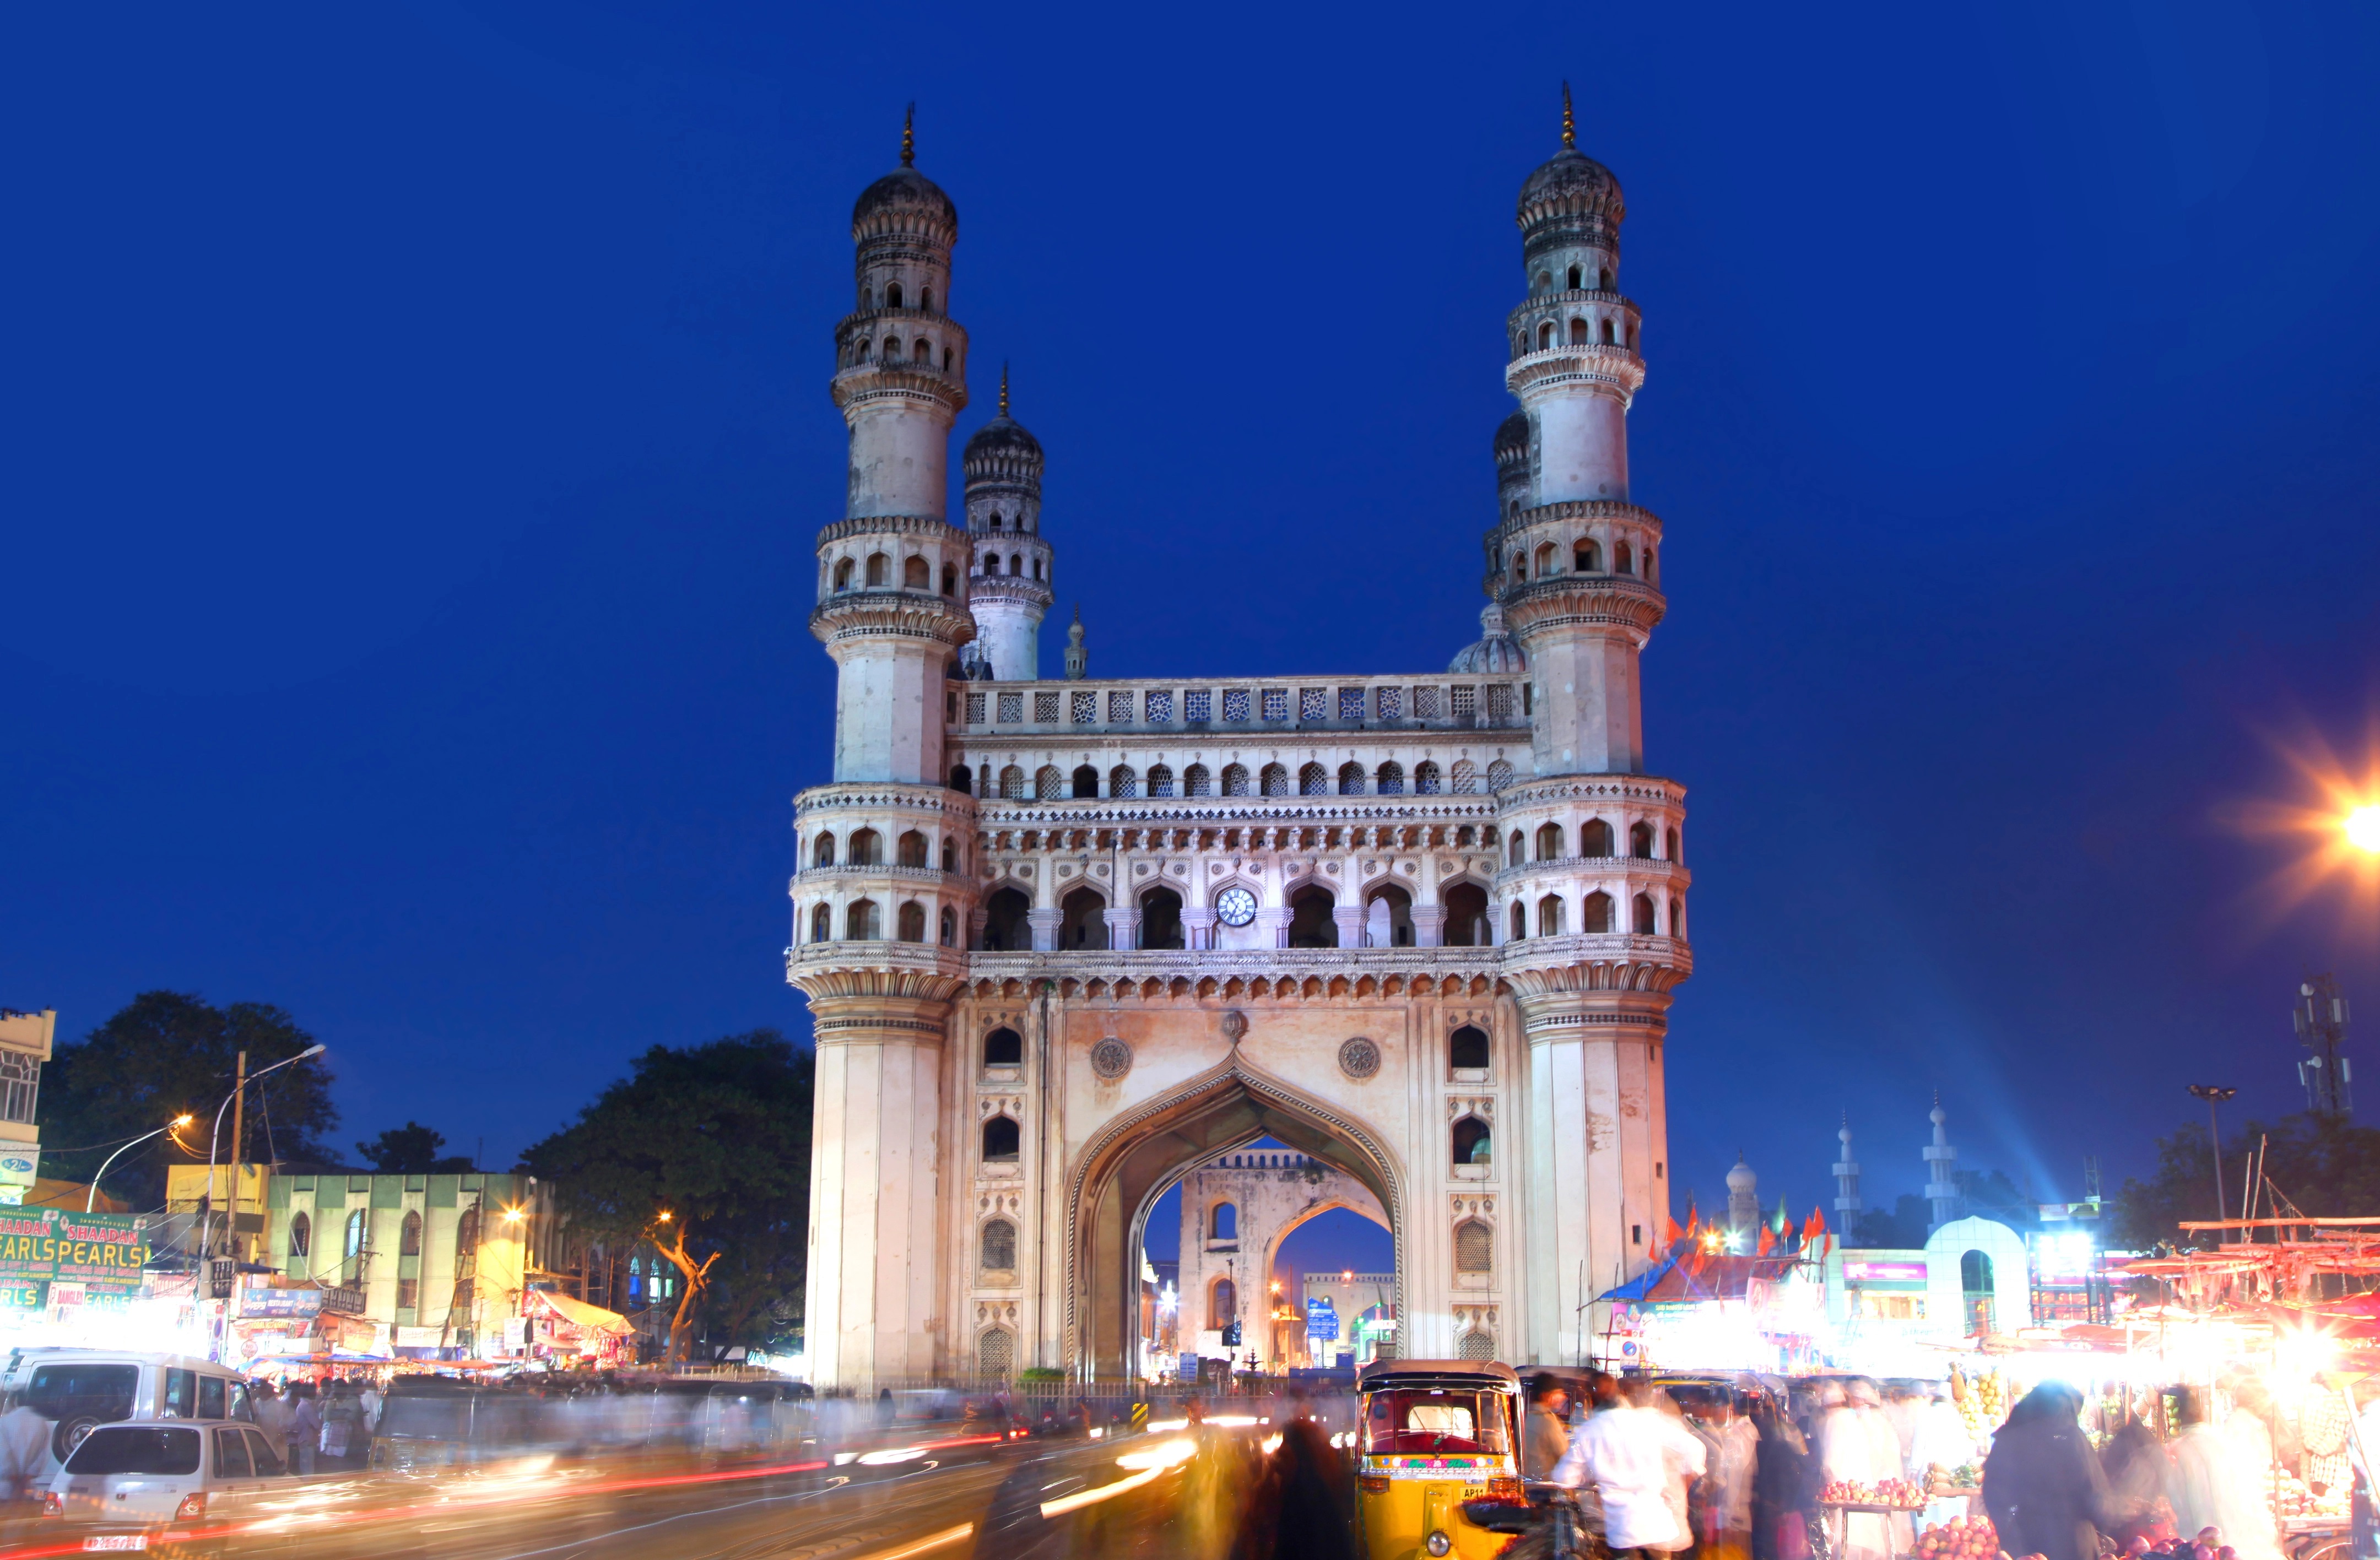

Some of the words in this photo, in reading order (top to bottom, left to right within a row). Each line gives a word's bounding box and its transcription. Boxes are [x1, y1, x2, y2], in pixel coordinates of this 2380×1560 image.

[67, 1225, 138, 1245] SHAADAN
[0, 1236, 56, 1261] ARLS
[58, 1241, 142, 1268] PEARLS
[57, 1290, 83, 1306] BANGLES
[1464, 1488, 1484, 1499] AP11
